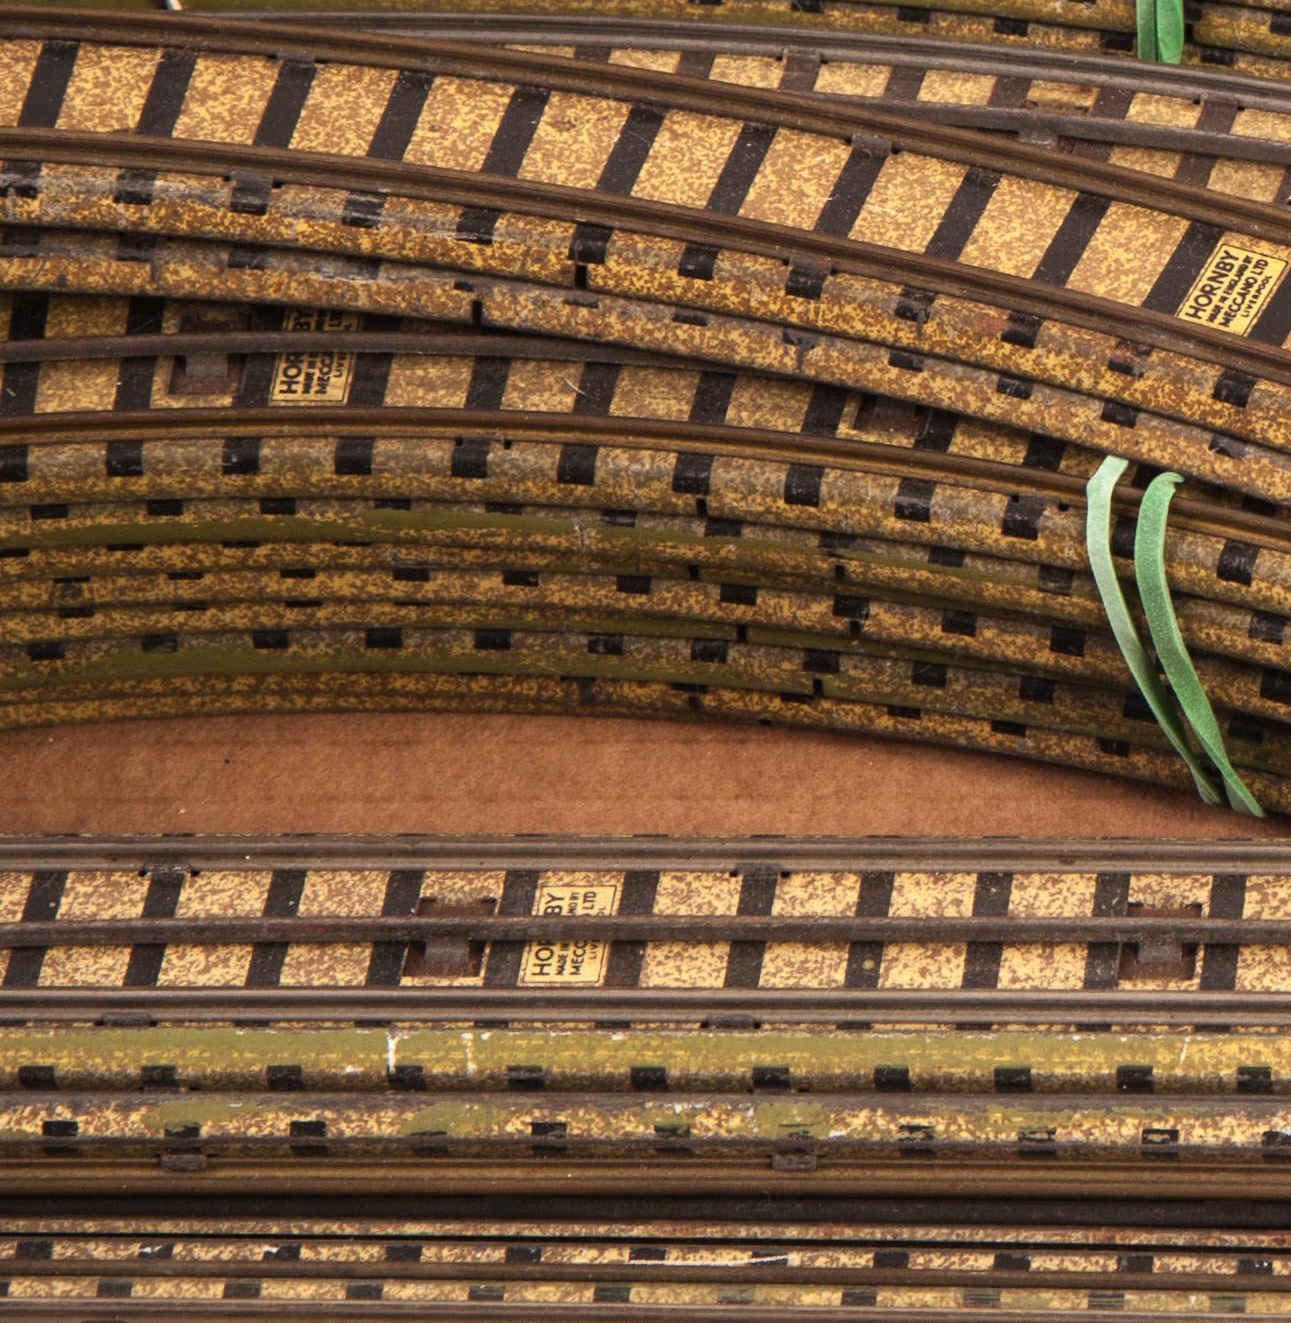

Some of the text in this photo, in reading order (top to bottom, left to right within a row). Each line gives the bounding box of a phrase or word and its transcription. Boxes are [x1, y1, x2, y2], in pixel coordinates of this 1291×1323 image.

[1185, 250, 1239, 319] HORNBY
[1219, 259, 1268, 327] MECCANO LTD
[581, 891, 596, 909] LTD
